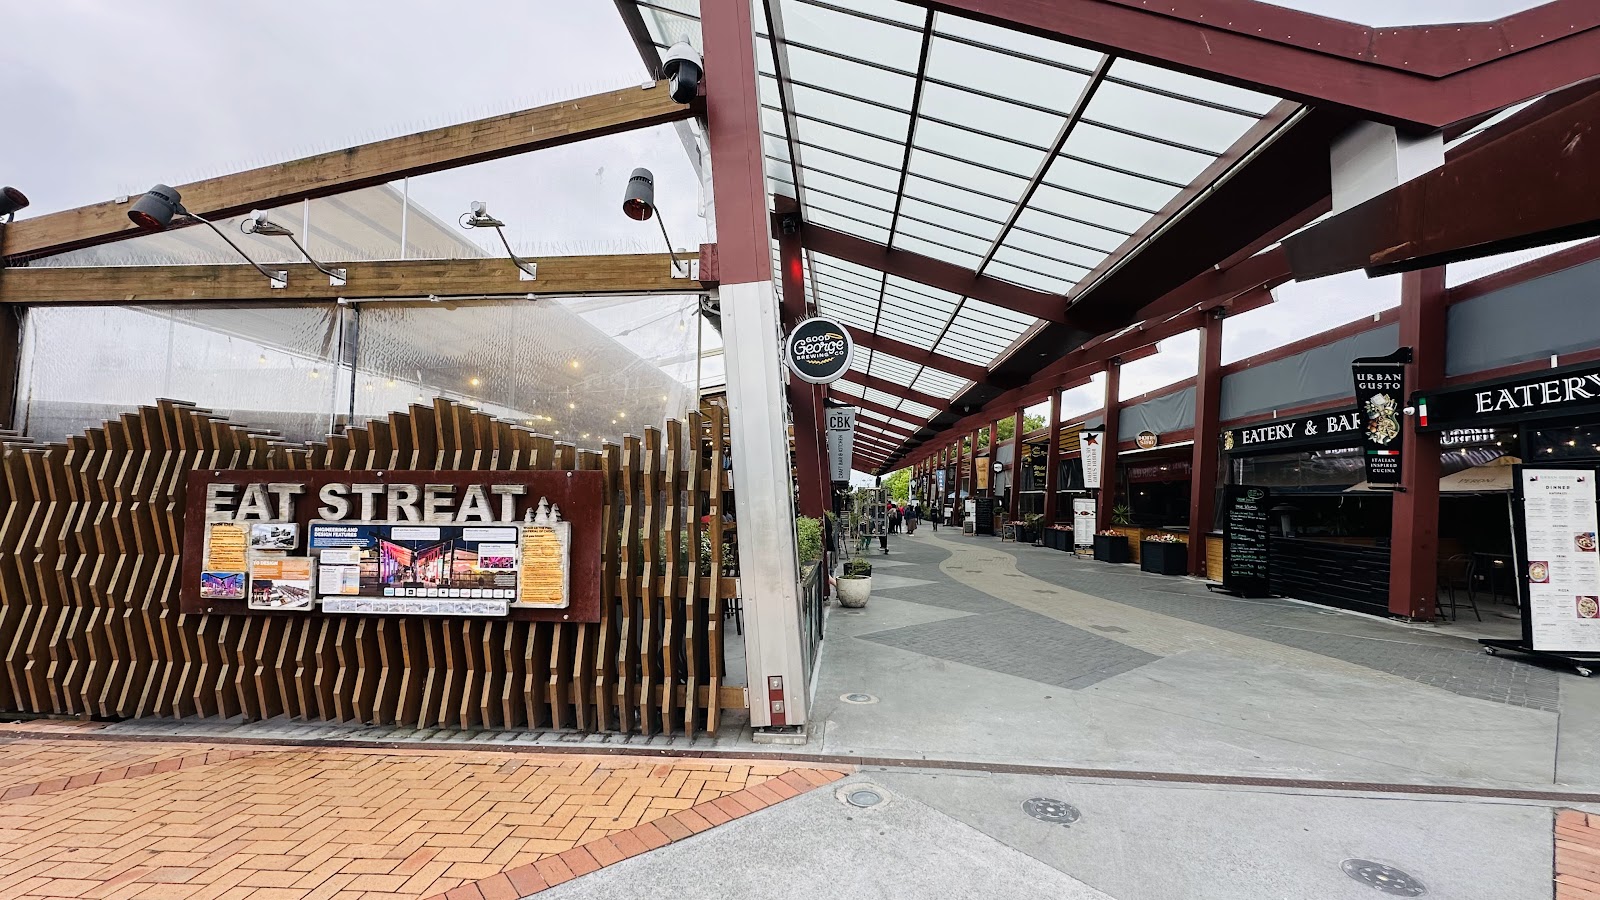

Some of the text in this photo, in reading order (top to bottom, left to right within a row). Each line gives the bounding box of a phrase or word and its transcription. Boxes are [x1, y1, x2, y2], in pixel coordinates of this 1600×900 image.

[806, 335, 830, 343] GOOD
[794, 340, 844, 355] George
[796, 352, 829, 360] BREWING
[1356, 373, 1401, 381] URBAN
[1359, 382, 1401, 390] GUSTO
[830, 416, 851, 428] CBK
[1242, 422, 1296, 444] EATERY
[1304, 420, 1318, 436] &
[205, 483, 527, 522] EAT STREAT
